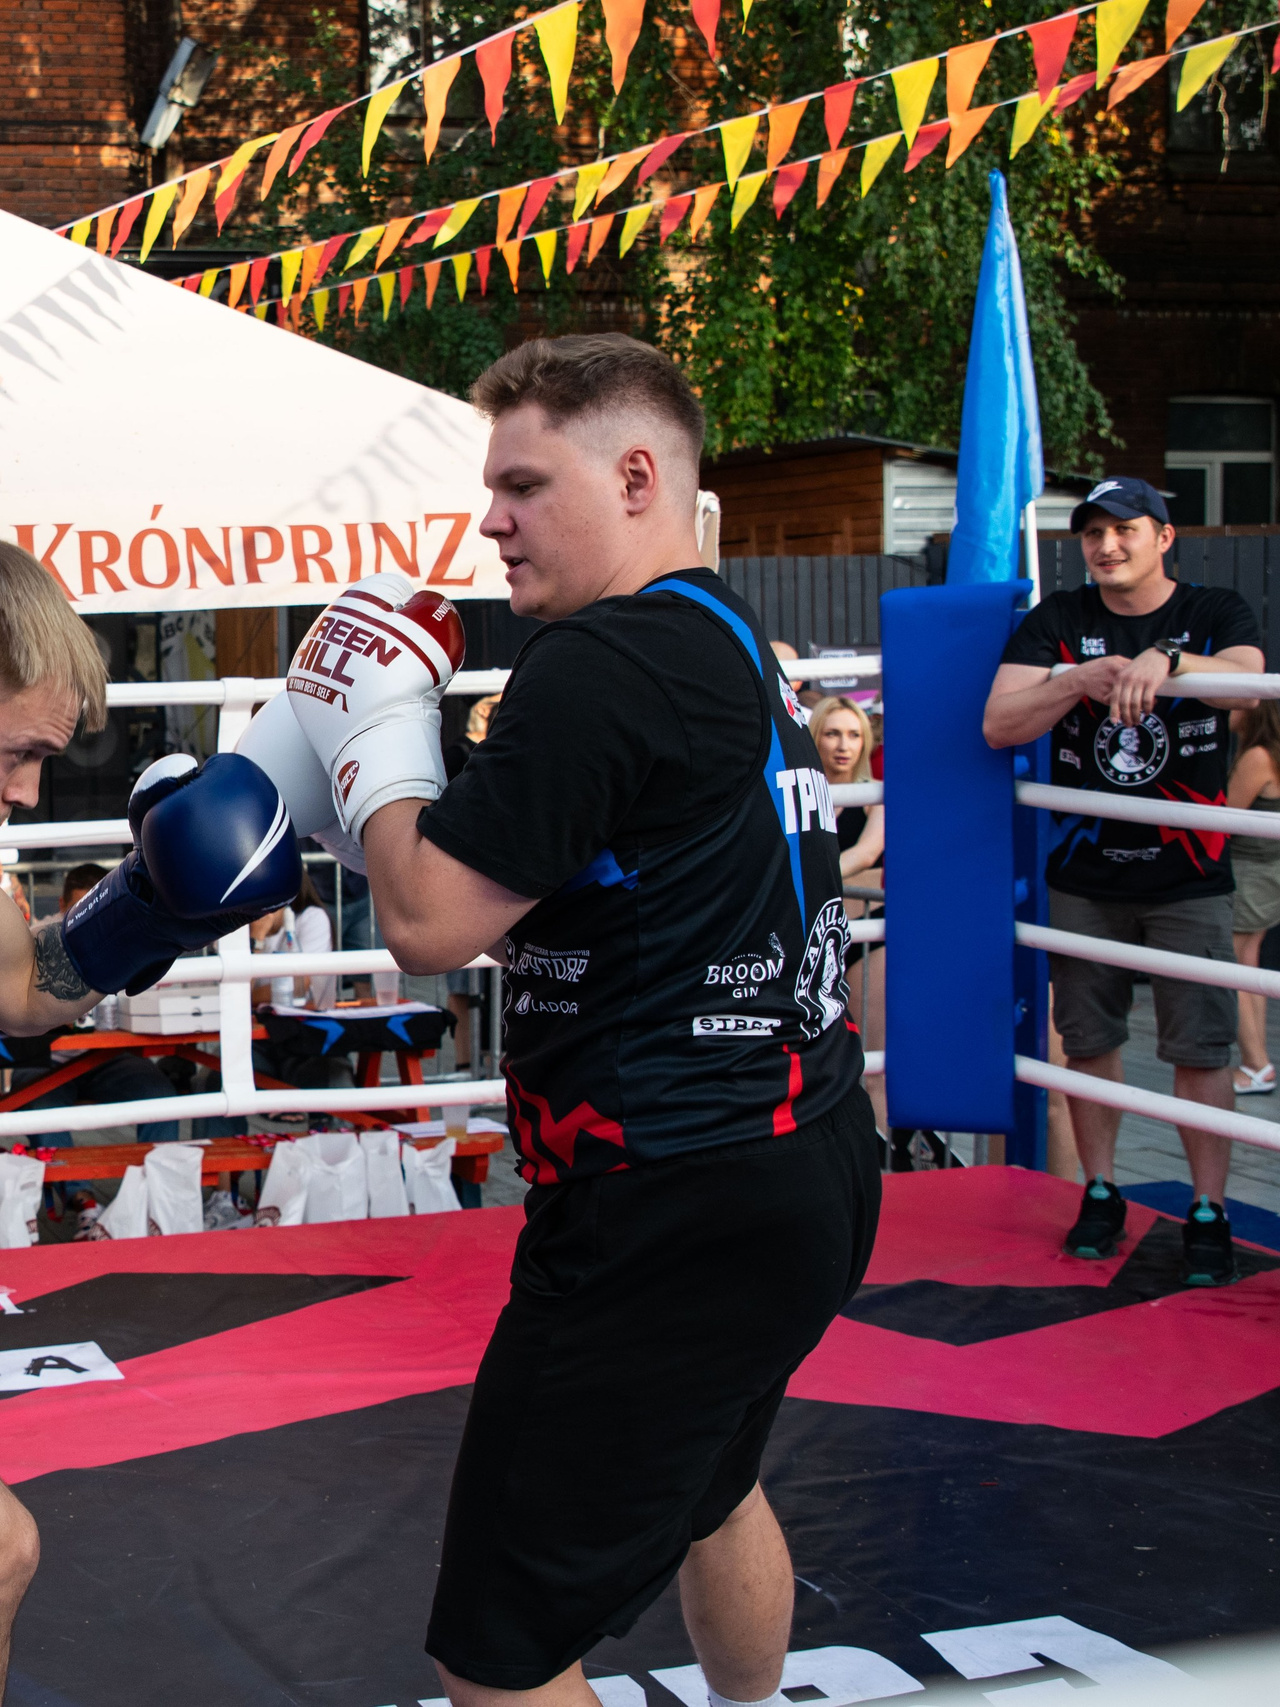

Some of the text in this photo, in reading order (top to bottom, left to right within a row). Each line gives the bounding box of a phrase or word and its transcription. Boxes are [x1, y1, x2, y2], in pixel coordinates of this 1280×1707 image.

[292, 639, 356, 688] HILL
[304, 680, 318, 695] BEST
[316, 686, 331, 700] SELF
[1105, 764, 1157, 783] 2010
[704, 958, 784, 985] BROOM
[732, 986, 760, 999] GIN
